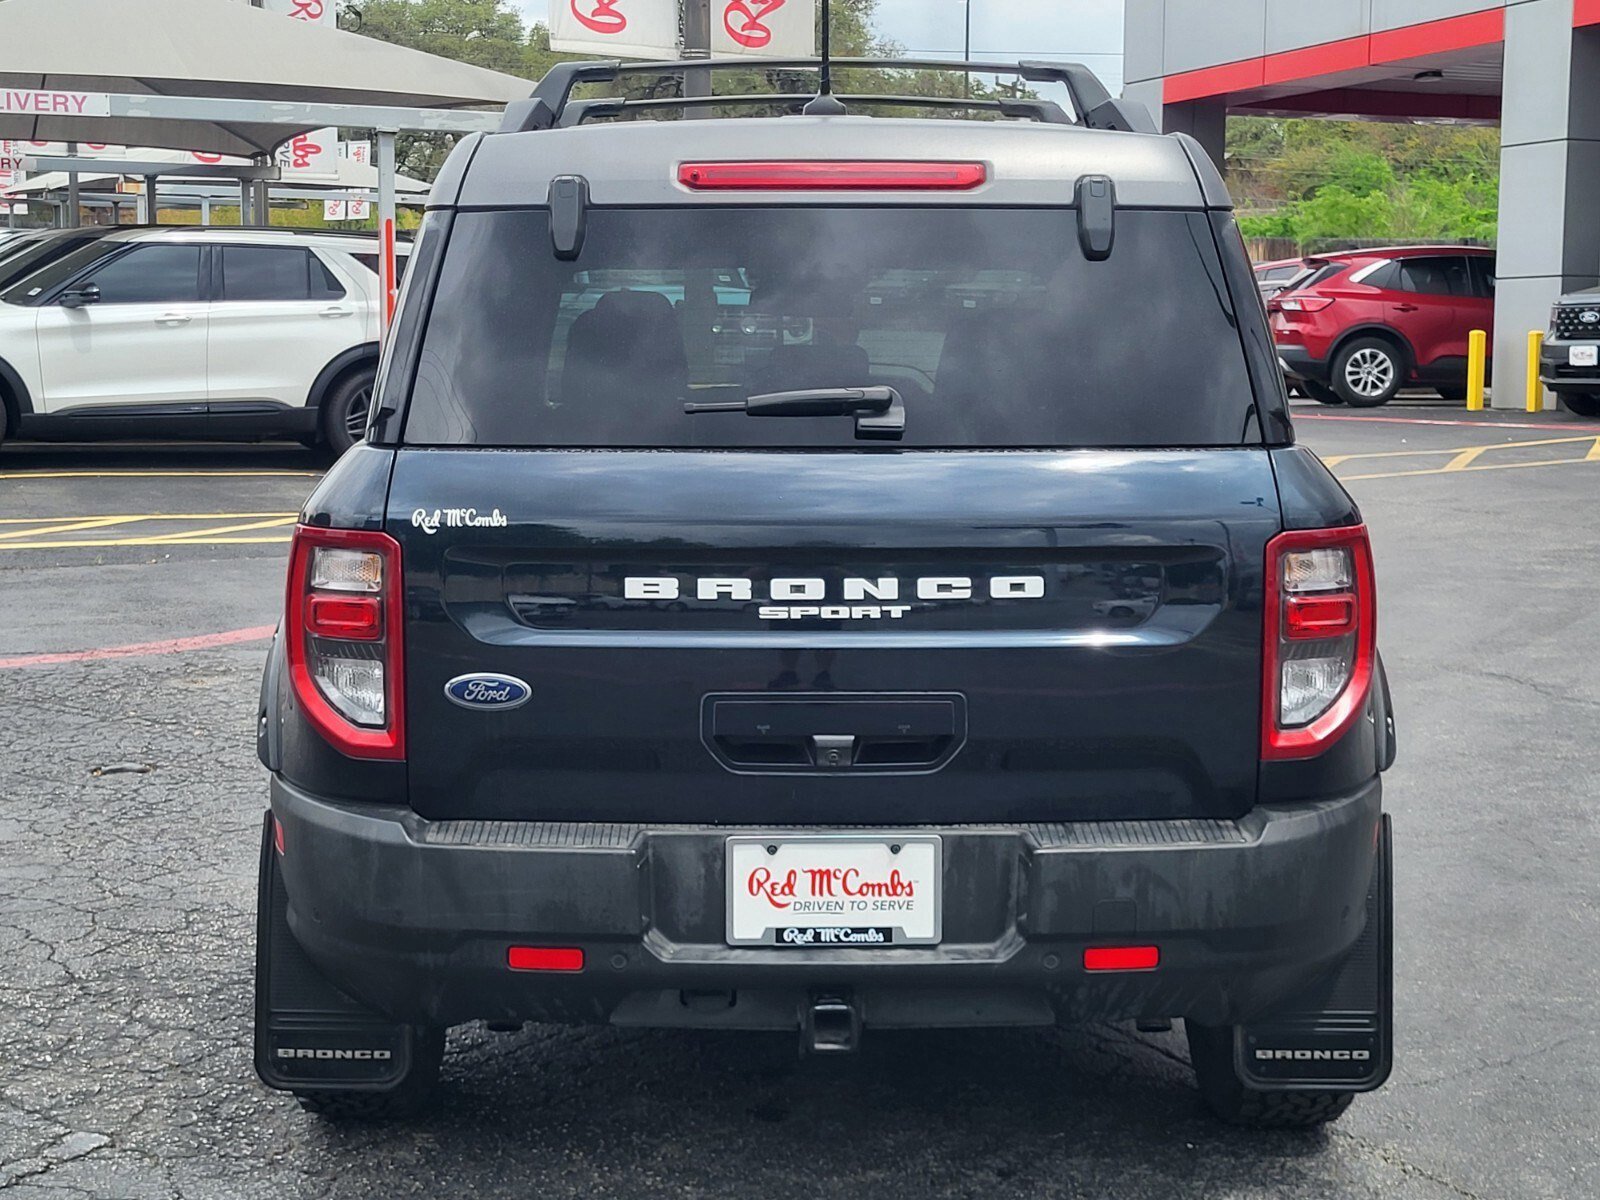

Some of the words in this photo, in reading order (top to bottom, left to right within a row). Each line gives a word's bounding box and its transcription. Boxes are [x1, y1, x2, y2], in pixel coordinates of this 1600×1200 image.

[412, 508, 440, 534] Red
[443, 508, 508, 528] McCombs
[624, 576, 1045, 600] BRONCO
[759, 605, 911, 619] SPORT
[464, 680, 511, 702] Ford
[748, 867, 797, 908] Red
[802, 868, 914, 897] McCombs
[793, 900, 845, 912] DRIVEN
[850, 900, 868, 911] TO
[872, 900, 914, 911] SERVE
[783, 928, 814, 944] Red
[815, 928, 884, 942] McCombs
[277, 1048, 391, 1059] BRONCO
[1255, 1050, 1370, 1060] BRONCO
